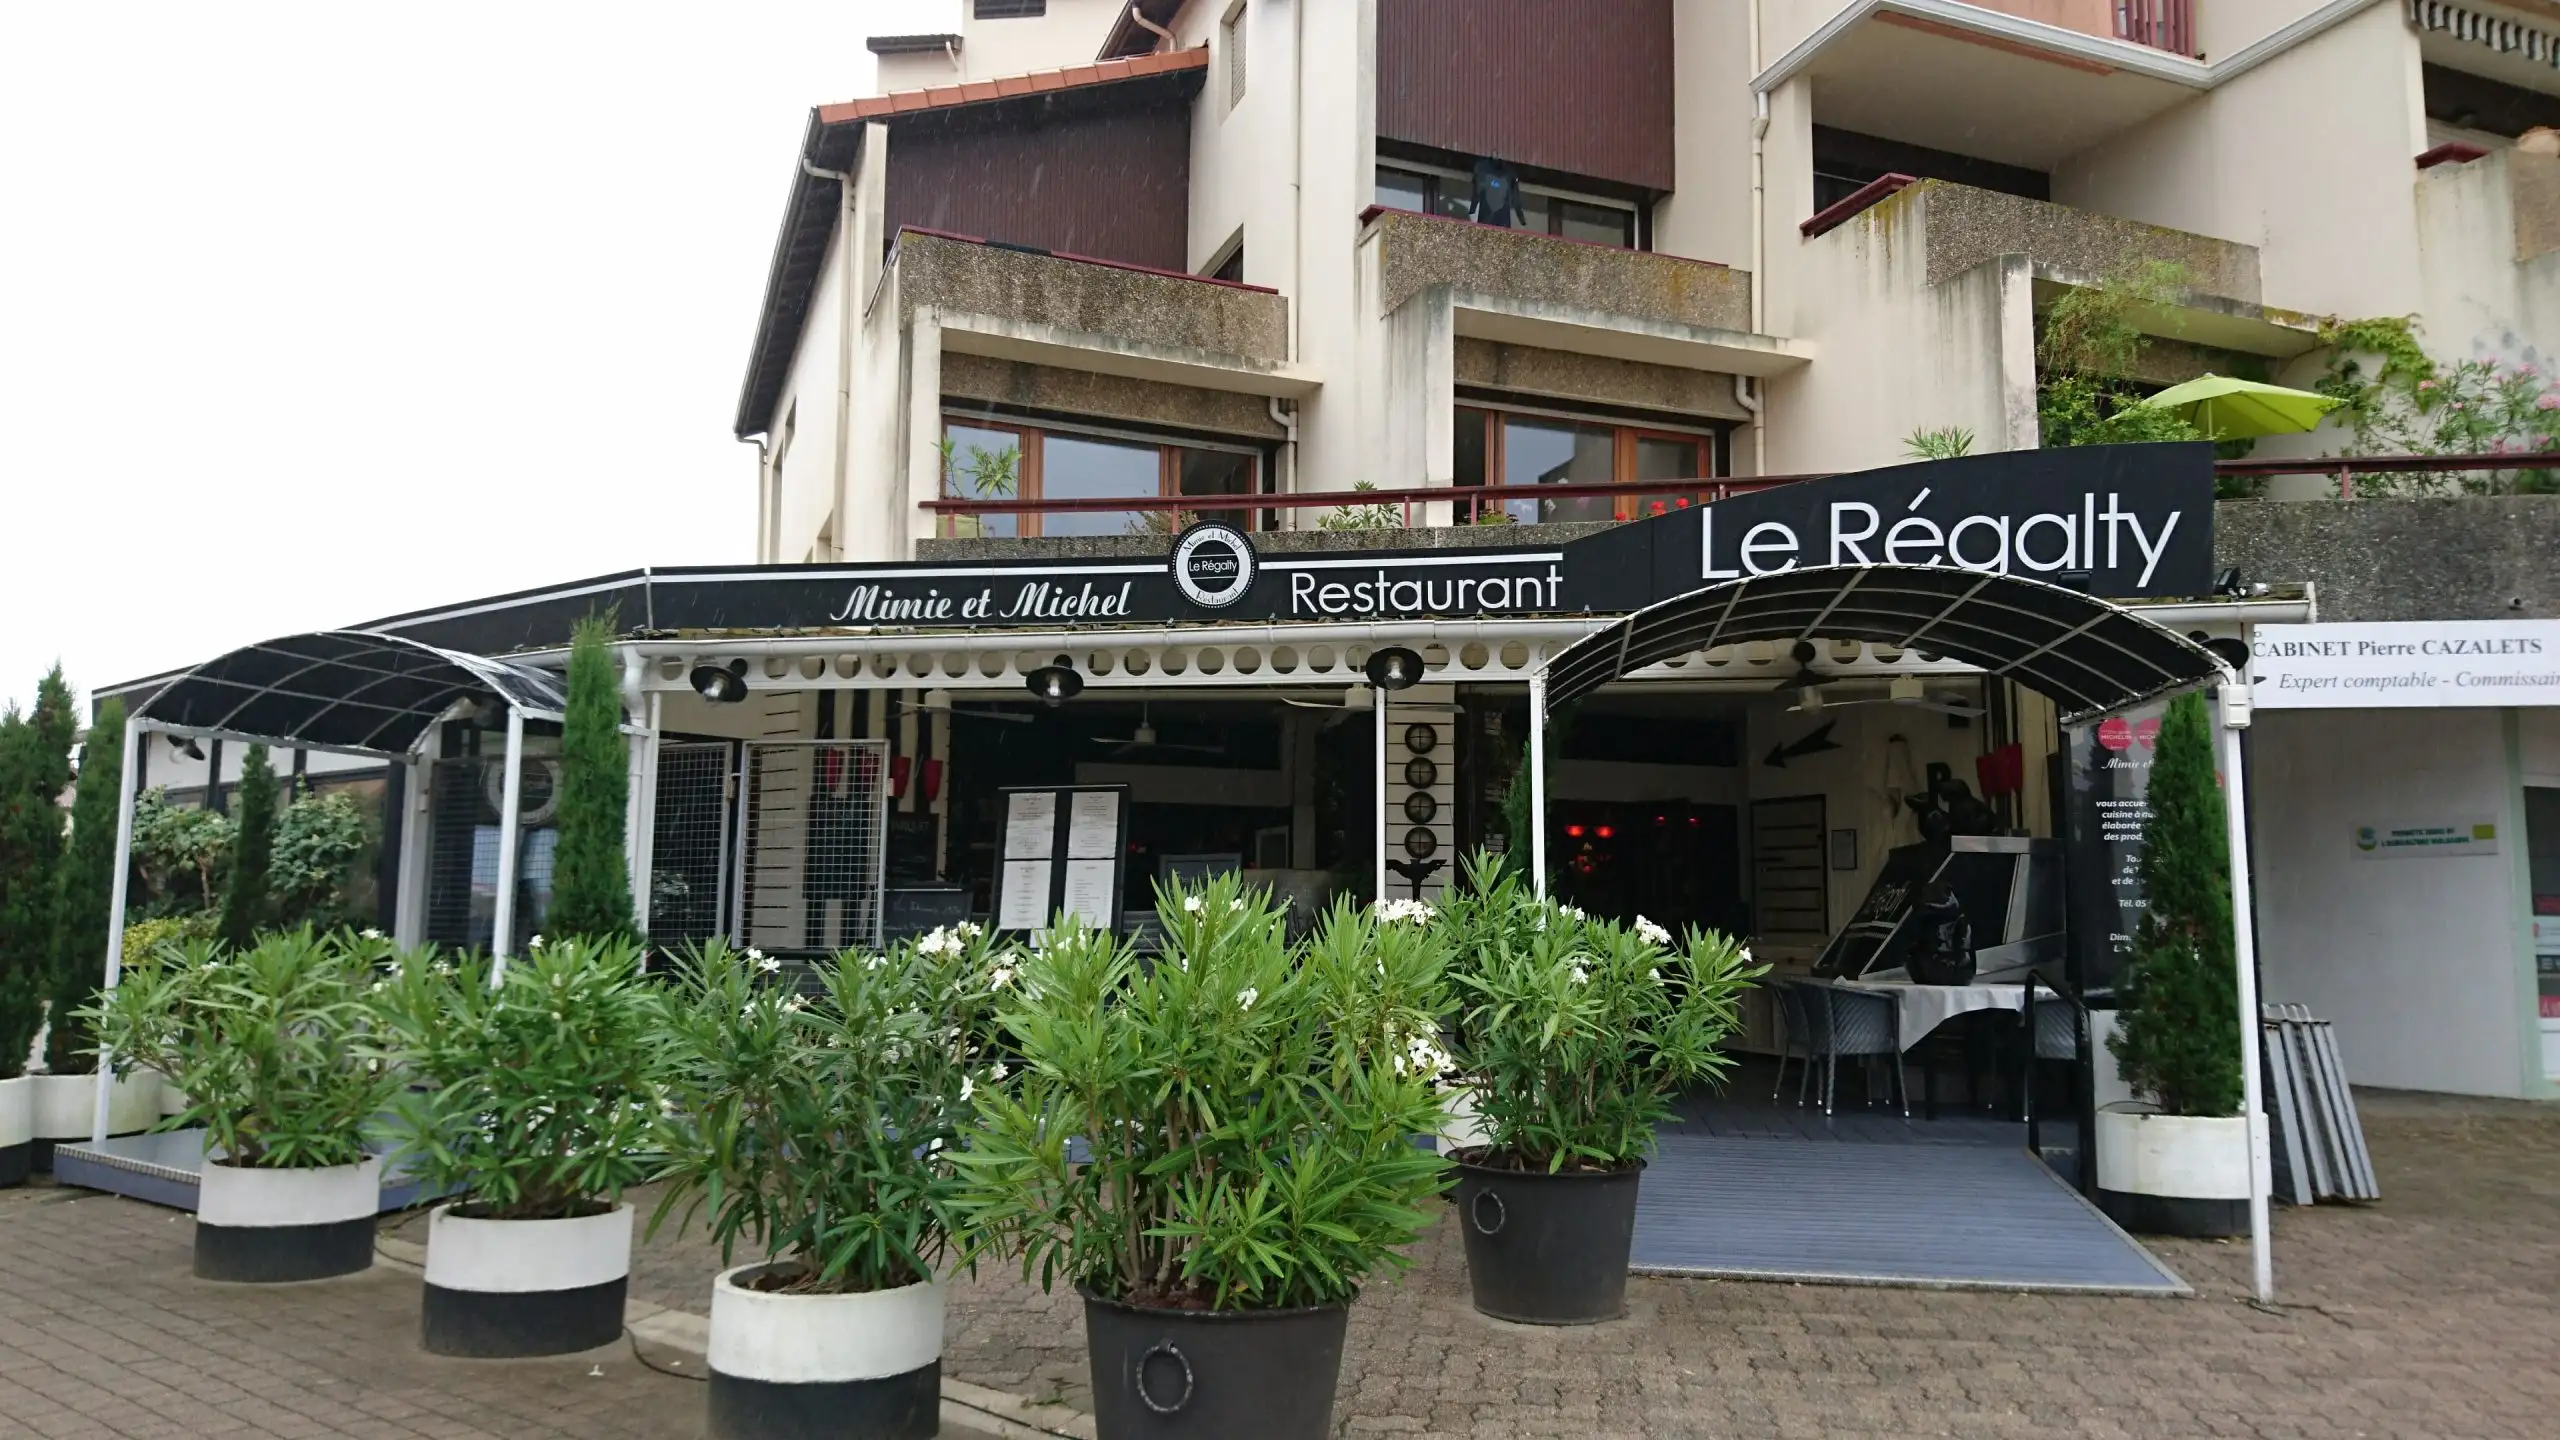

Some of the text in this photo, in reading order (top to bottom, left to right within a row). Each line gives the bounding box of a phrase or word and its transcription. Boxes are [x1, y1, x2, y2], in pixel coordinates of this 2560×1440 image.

[1219, 531, 1243, 551] Michel
[1702, 487, 2181, 588] Le Régalty
[1188, 559, 1238, 573] Le Régalty
[1196, 587, 1239, 604] Restaurant
[1291, 564, 1563, 613] Restaurant
[830, 581, 1132, 620] Mimie et Michel
[2253, 638, 2542, 657] CABINET Pierre CAZALETS
[2279, 673, 2338, 693] Expert
[2344, 671, 2436, 692] comptable
[2101, 757, 2140, 769] Mimie
[2102, 810, 2133, 819] cuisine
[2134, 810, 2140, 819] à
[2103, 832, 2144, 842] des prod
[2122, 877, 2133, 885] de
[2135, 899, 2147, 907] 05
[2110, 933, 2132, 941] Dim
